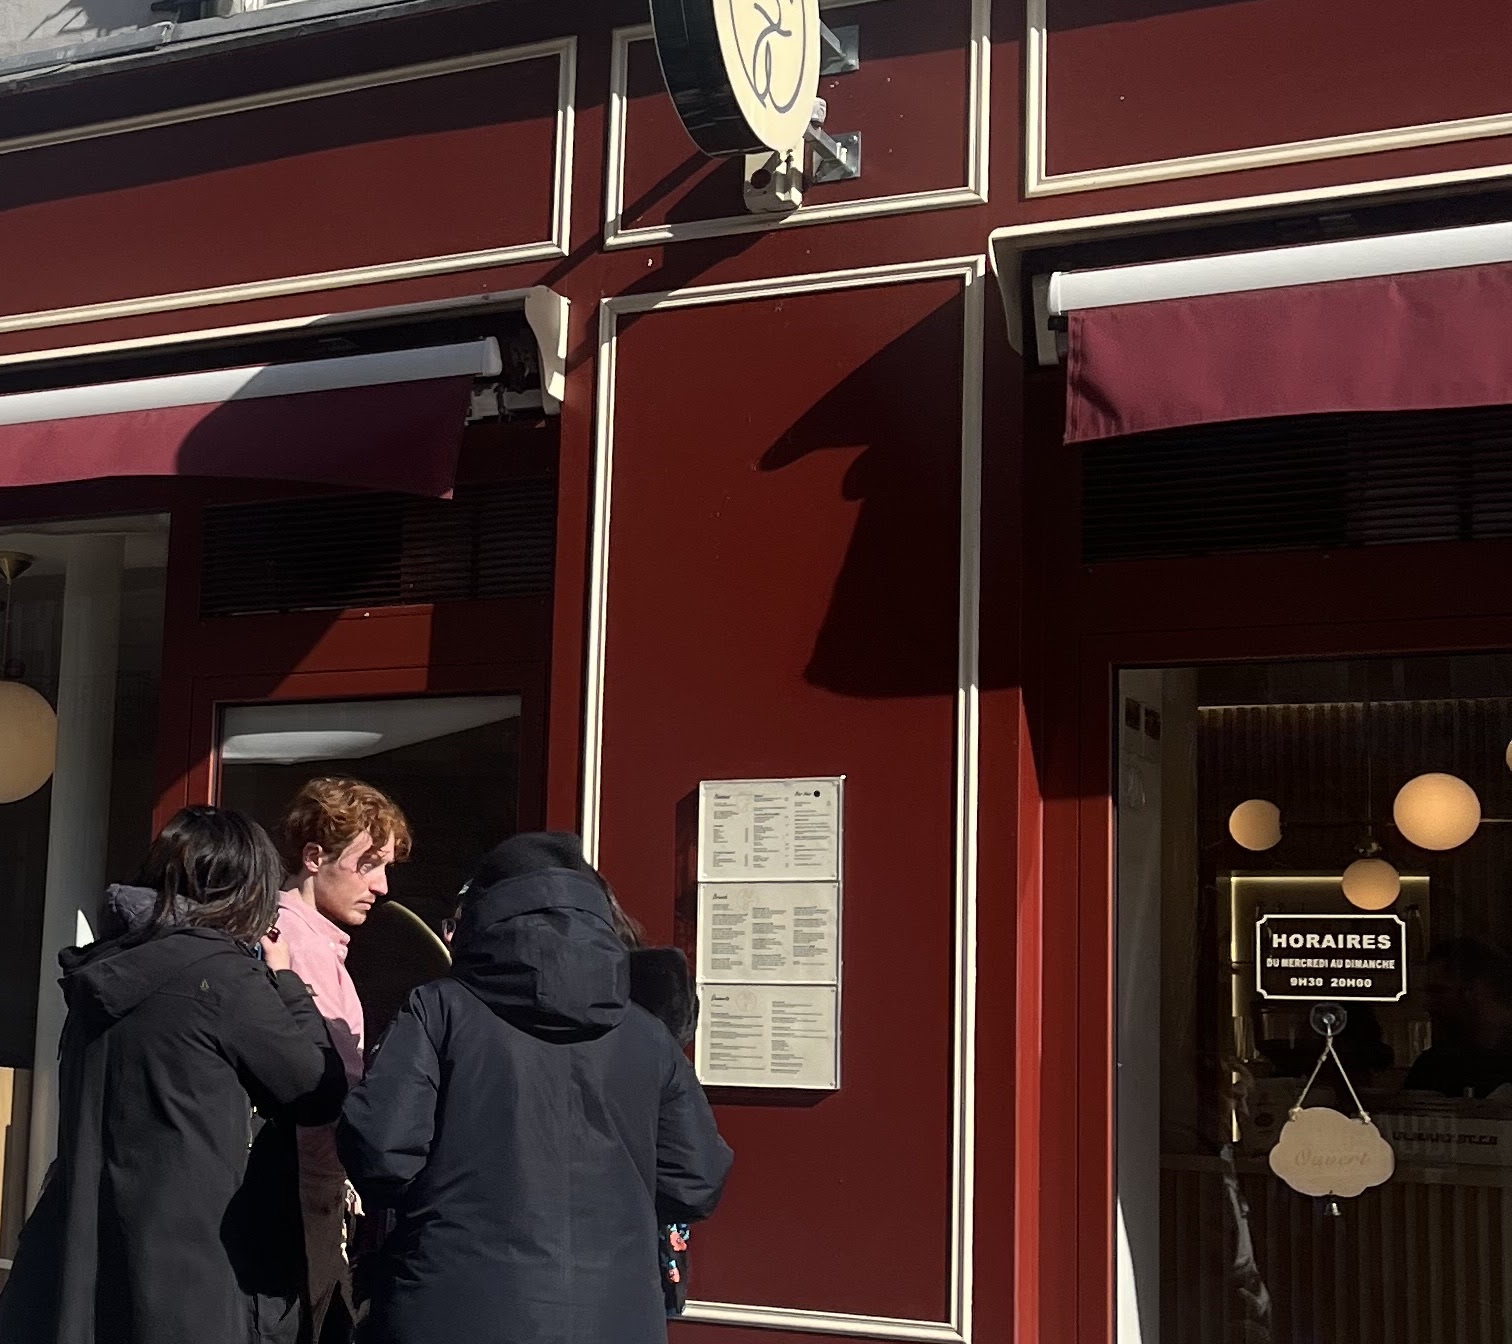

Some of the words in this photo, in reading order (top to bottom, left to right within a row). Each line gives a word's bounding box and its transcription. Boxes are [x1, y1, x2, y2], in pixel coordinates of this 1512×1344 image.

[1272, 933, 1392, 949] HORAIRES
[1266, 958, 1279, 968] DU
[1281, 958, 1329, 968] MERCREDI
[1330, 958, 1344, 969] AU
[1345, 959, 1395, 969] DIMANCHE
[1290, 977, 1323, 987] 9H30
[1330, 978, 1372, 988] 20H00
